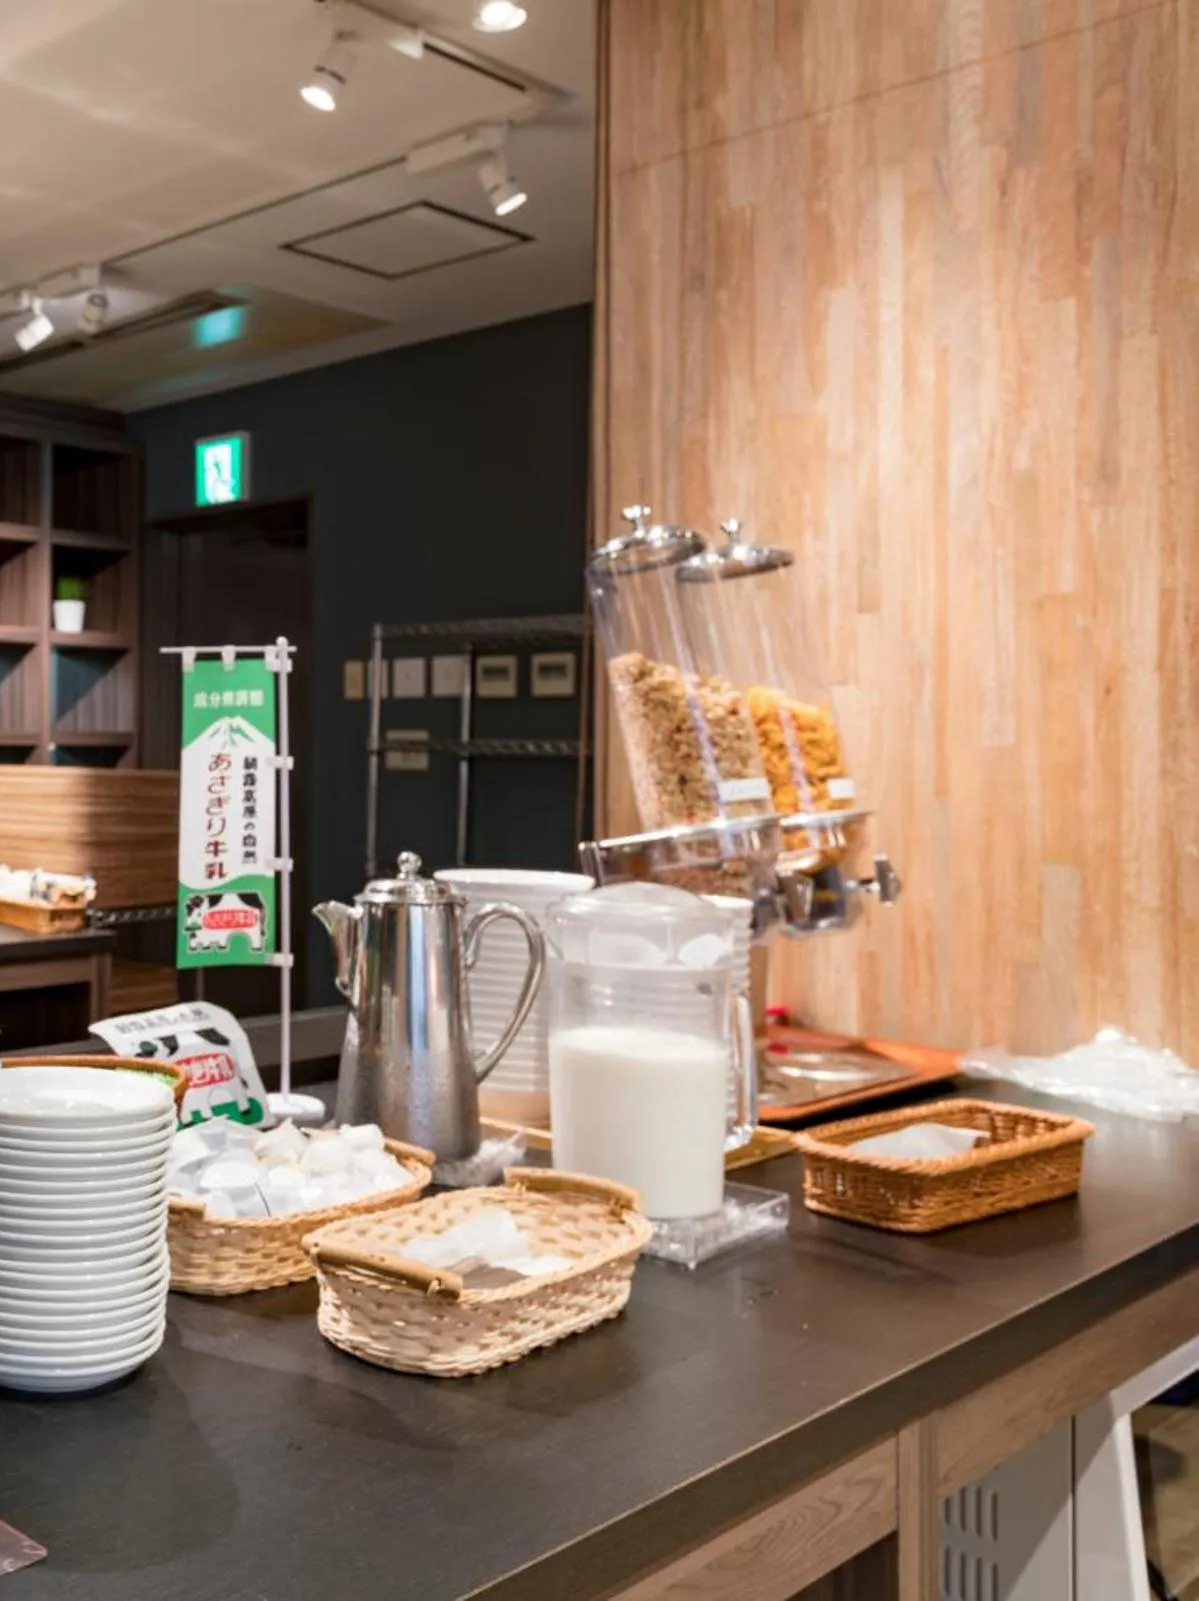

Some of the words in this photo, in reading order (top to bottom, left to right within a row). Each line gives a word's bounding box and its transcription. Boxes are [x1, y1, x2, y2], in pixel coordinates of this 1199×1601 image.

[204, 752, 231, 880] あさぎり牛乳
